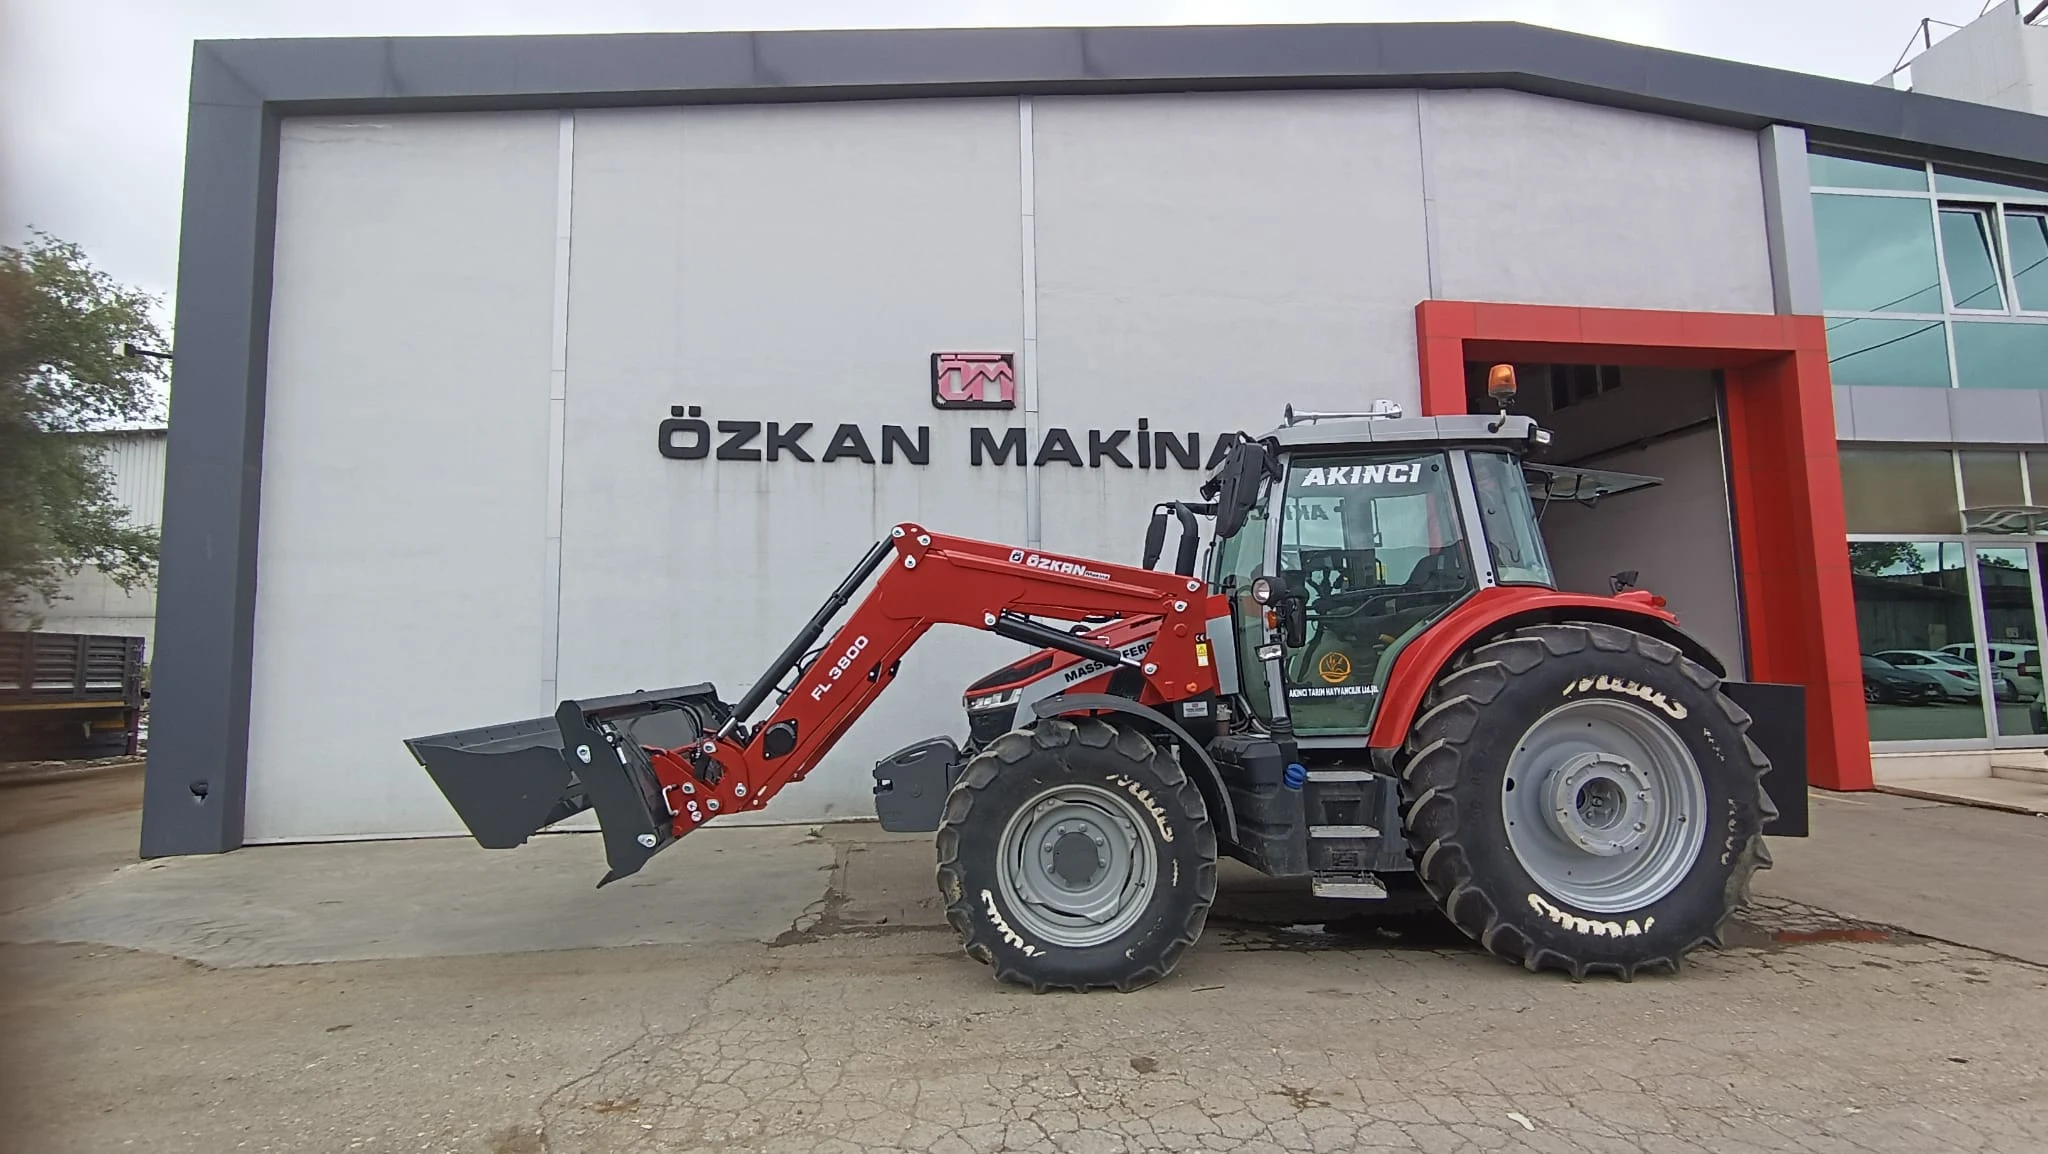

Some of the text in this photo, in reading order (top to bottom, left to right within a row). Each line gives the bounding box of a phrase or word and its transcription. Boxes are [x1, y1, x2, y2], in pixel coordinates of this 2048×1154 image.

[658, 405, 930, 465] ÖZKAN
[1301, 463, 1422, 487] AKINCI
[1026, 554, 1086, 576] ÖZKAN
[811, 635, 868, 701] FL 3800
[1064, 660, 1106, 683] MASS
[1289, 688, 1308, 698] AKINCI
[1308, 687, 1325, 697] TARIM
